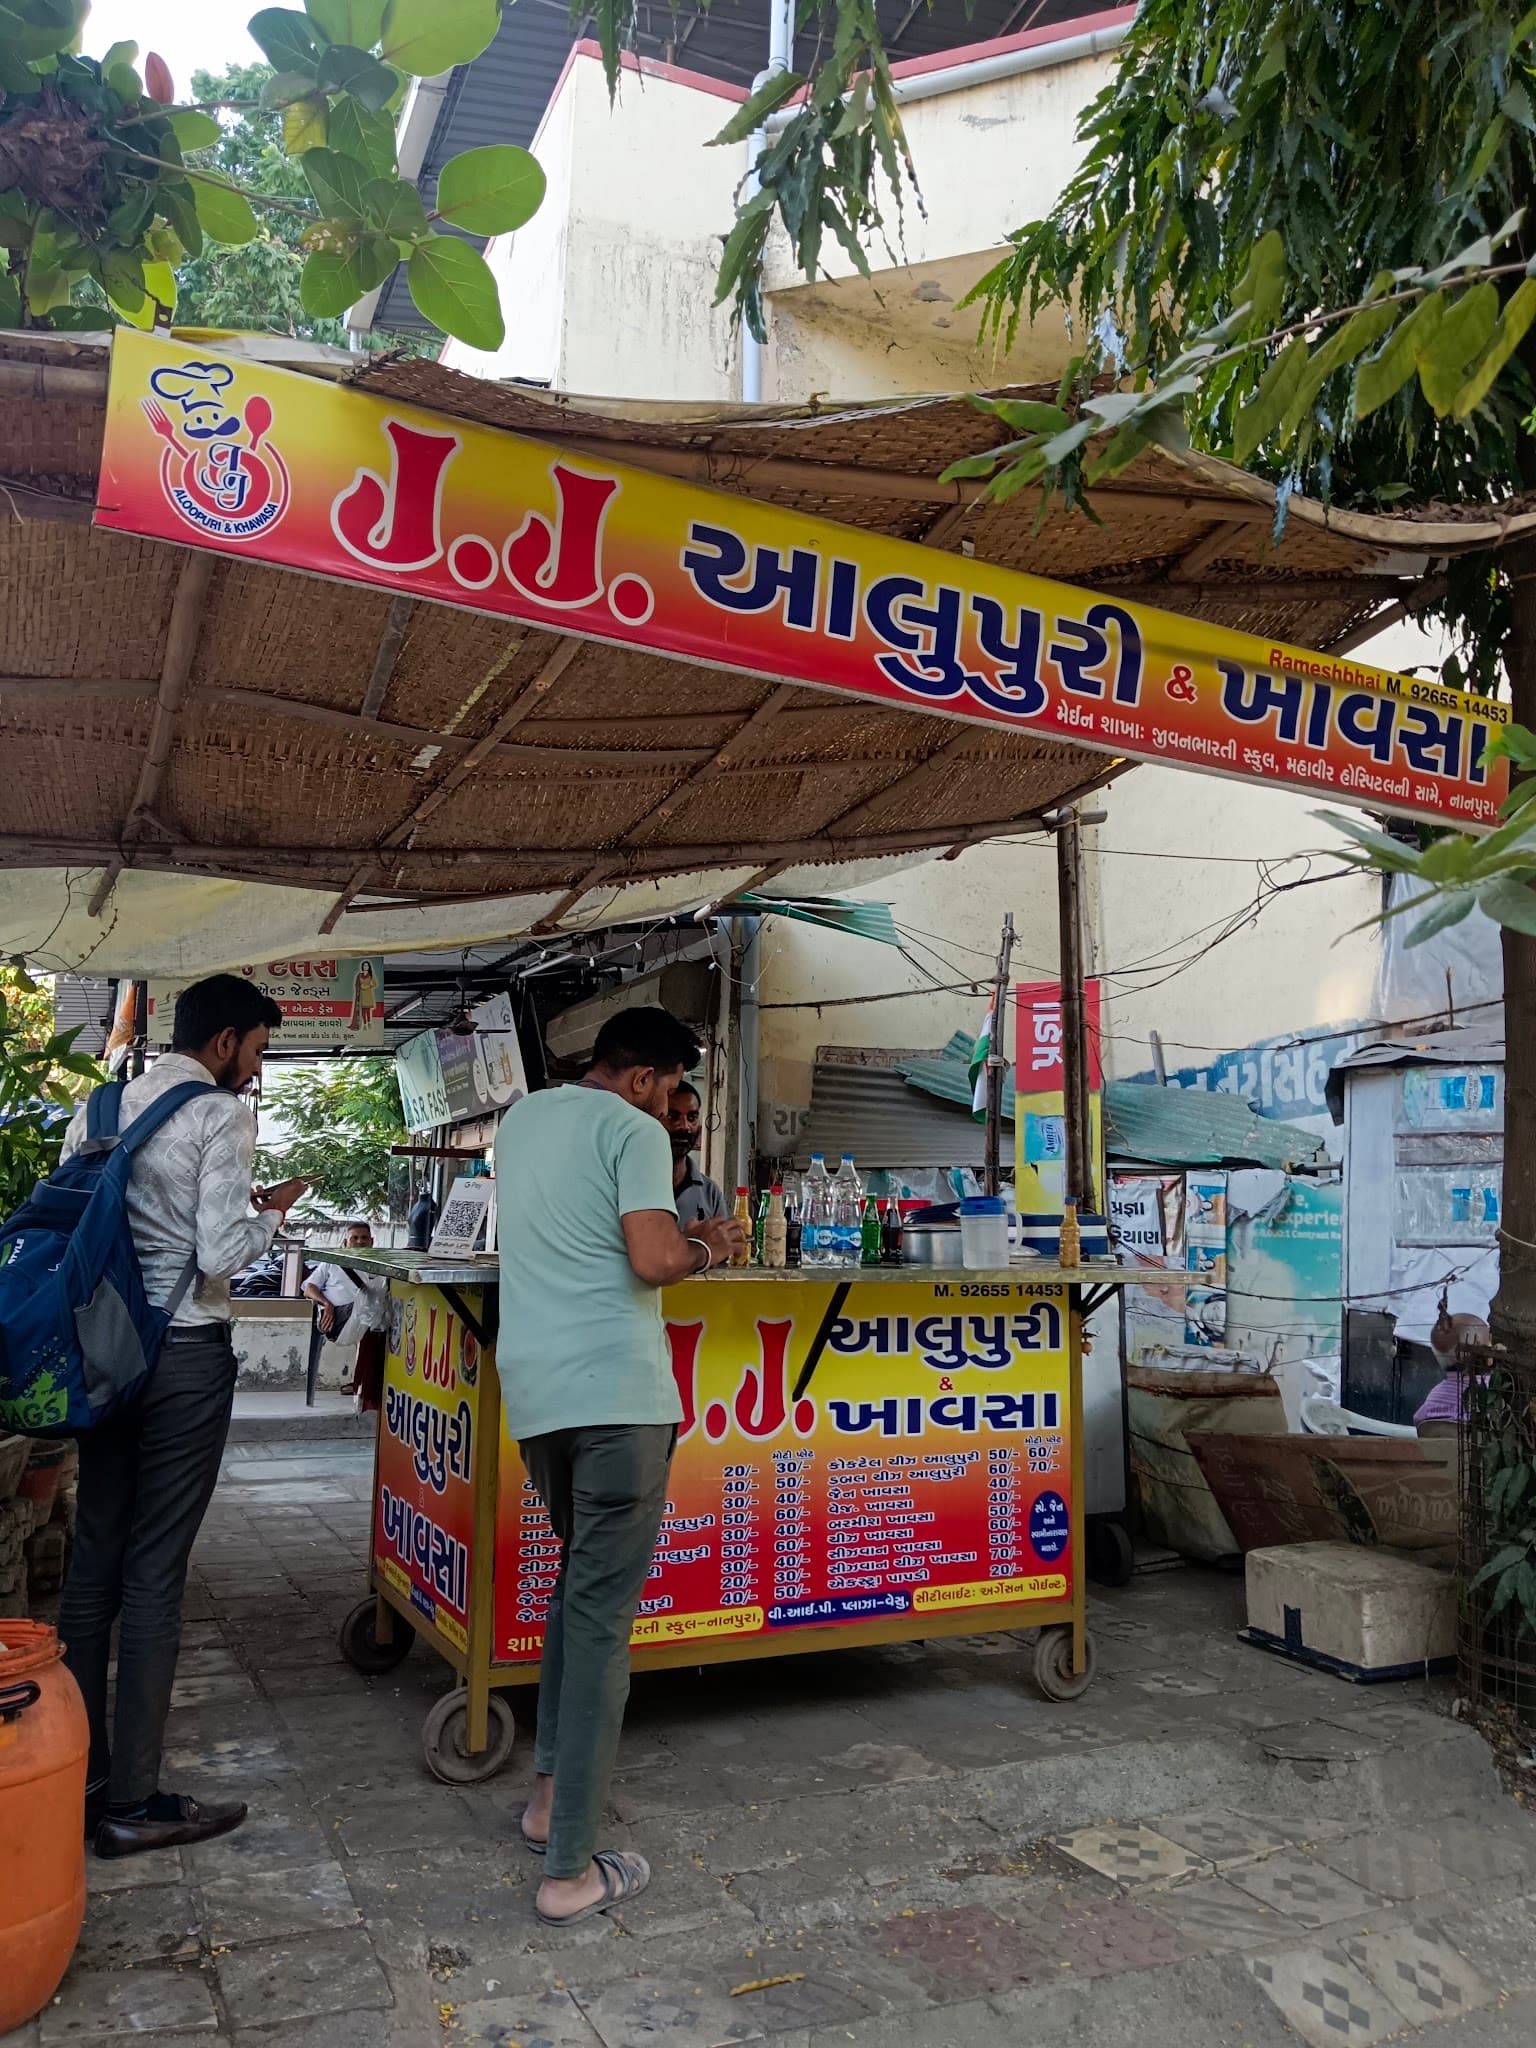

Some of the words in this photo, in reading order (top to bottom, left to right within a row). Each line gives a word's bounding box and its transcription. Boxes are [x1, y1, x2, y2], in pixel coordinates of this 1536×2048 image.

[173, 488, 221, 532] ALOOPURI
[224, 522, 232, 533] &
[233, 503, 278, 533] KHAWASA
[330, 415, 655, 627] J.J.
[678, 520, 1143, 717] આલુપુરી
[1165, 664, 1198, 704] &
[1217, 657, 1487, 786] ખાવસા
[1269, 647, 1381, 690] Rameshbhai
[1386, 676, 1406, 697] M.
[1411, 684, 1458, 709] 92655
[1463, 698, 1508, 723] 14453
[1152, 727, 1238, 761] જીવનભારતી
[1286, 757, 1335, 782] મહાવીર
[934, 1284, 954, 1297] M.
[960, 1284, 1010, 1297] 92655
[1016, 1283, 1063, 1297] 14453
[829, 1302, 1060, 1370] આલુપુરી
[422, 1306, 456, 1392] J.J.
[939, 1376, 953, 1391] &
[828, 1391, 1059, 1436] ખાવસા
[386, 1385, 473, 1494] આલુપુરી
[723, 1464, 759, 1478] 20/-
[776, 1461, 811, 1474] 30/-
[828, 1456, 882, 1470] કોકટેલ
[888, 1455, 917, 1466] ચીઝ
[923, 1451, 980, 1466] આલુપુરી
[988, 1447, 1020, 1461] 50/-
[1028, 1446, 1059, 1458] 60/-
[828, 1474, 867, 1486] ડબલ
[872, 1470, 902, 1481] ચીઝ
[908, 1466, 966, 1481] આલુપુરી
[988, 1462, 1020, 1475] 60/-
[1028, 1460, 1059, 1473] 70/-
[723, 1480, 759, 1493] 40/-
[776, 1477, 811, 1489] 50/-
[826, 1487, 856, 1500] જૈન
[862, 1485, 910, 1497] ખાવસા
[988, 1477, 1020, 1489] 40/-
[723, 1496, 759, 1510] 30/-
[776, 1491, 811, 1505] 40/-
[866, 1499, 913, 1512] ખાવસા
[988, 1489, 1021, 1503] 40/-
[722, 1512, 759, 1525] 50/-
[775, 1507, 811, 1520] 60/-
[887, 1513, 935, 1525] ખાવસા
[989, 1503, 1021, 1517] 50/-
[722, 1527, 759, 1541] 30/-
[775, 1522, 810, 1536] 40/-
[827, 1532, 859, 1544] ચીઝ
[865, 1529, 913, 1541] ખાવસા
[988, 1516, 1021, 1530] 60/-
[381, 1485, 468, 1615] ખાવસા
[722, 1543, 759, 1557] 50/-
[775, 1538, 810, 1552] 60/-
[827, 1545, 889, 1559] સીઝવાન
[894, 1540, 942, 1553] ખાવસા
[989, 1530, 1021, 1545] 50/-
[722, 1559, 758, 1573] 30/-
[775, 1554, 810, 1568] 40/-
[827, 1559, 889, 1575] સીઝવાન
[894, 1556, 924, 1567] ચીઝ
[930, 1551, 977, 1564] ખાવસા
[989, 1546, 1022, 1560] 70/-
[887, 1569, 929, 1583] પાપડી
[989, 1561, 1023, 1577] 20/-
[721, 1574, 758, 1589] 20/-
[775, 1568, 810, 1583] 30/-
[720, 1590, 758, 1605] 40/-
[775, 1584, 810, 1599] 50/-
